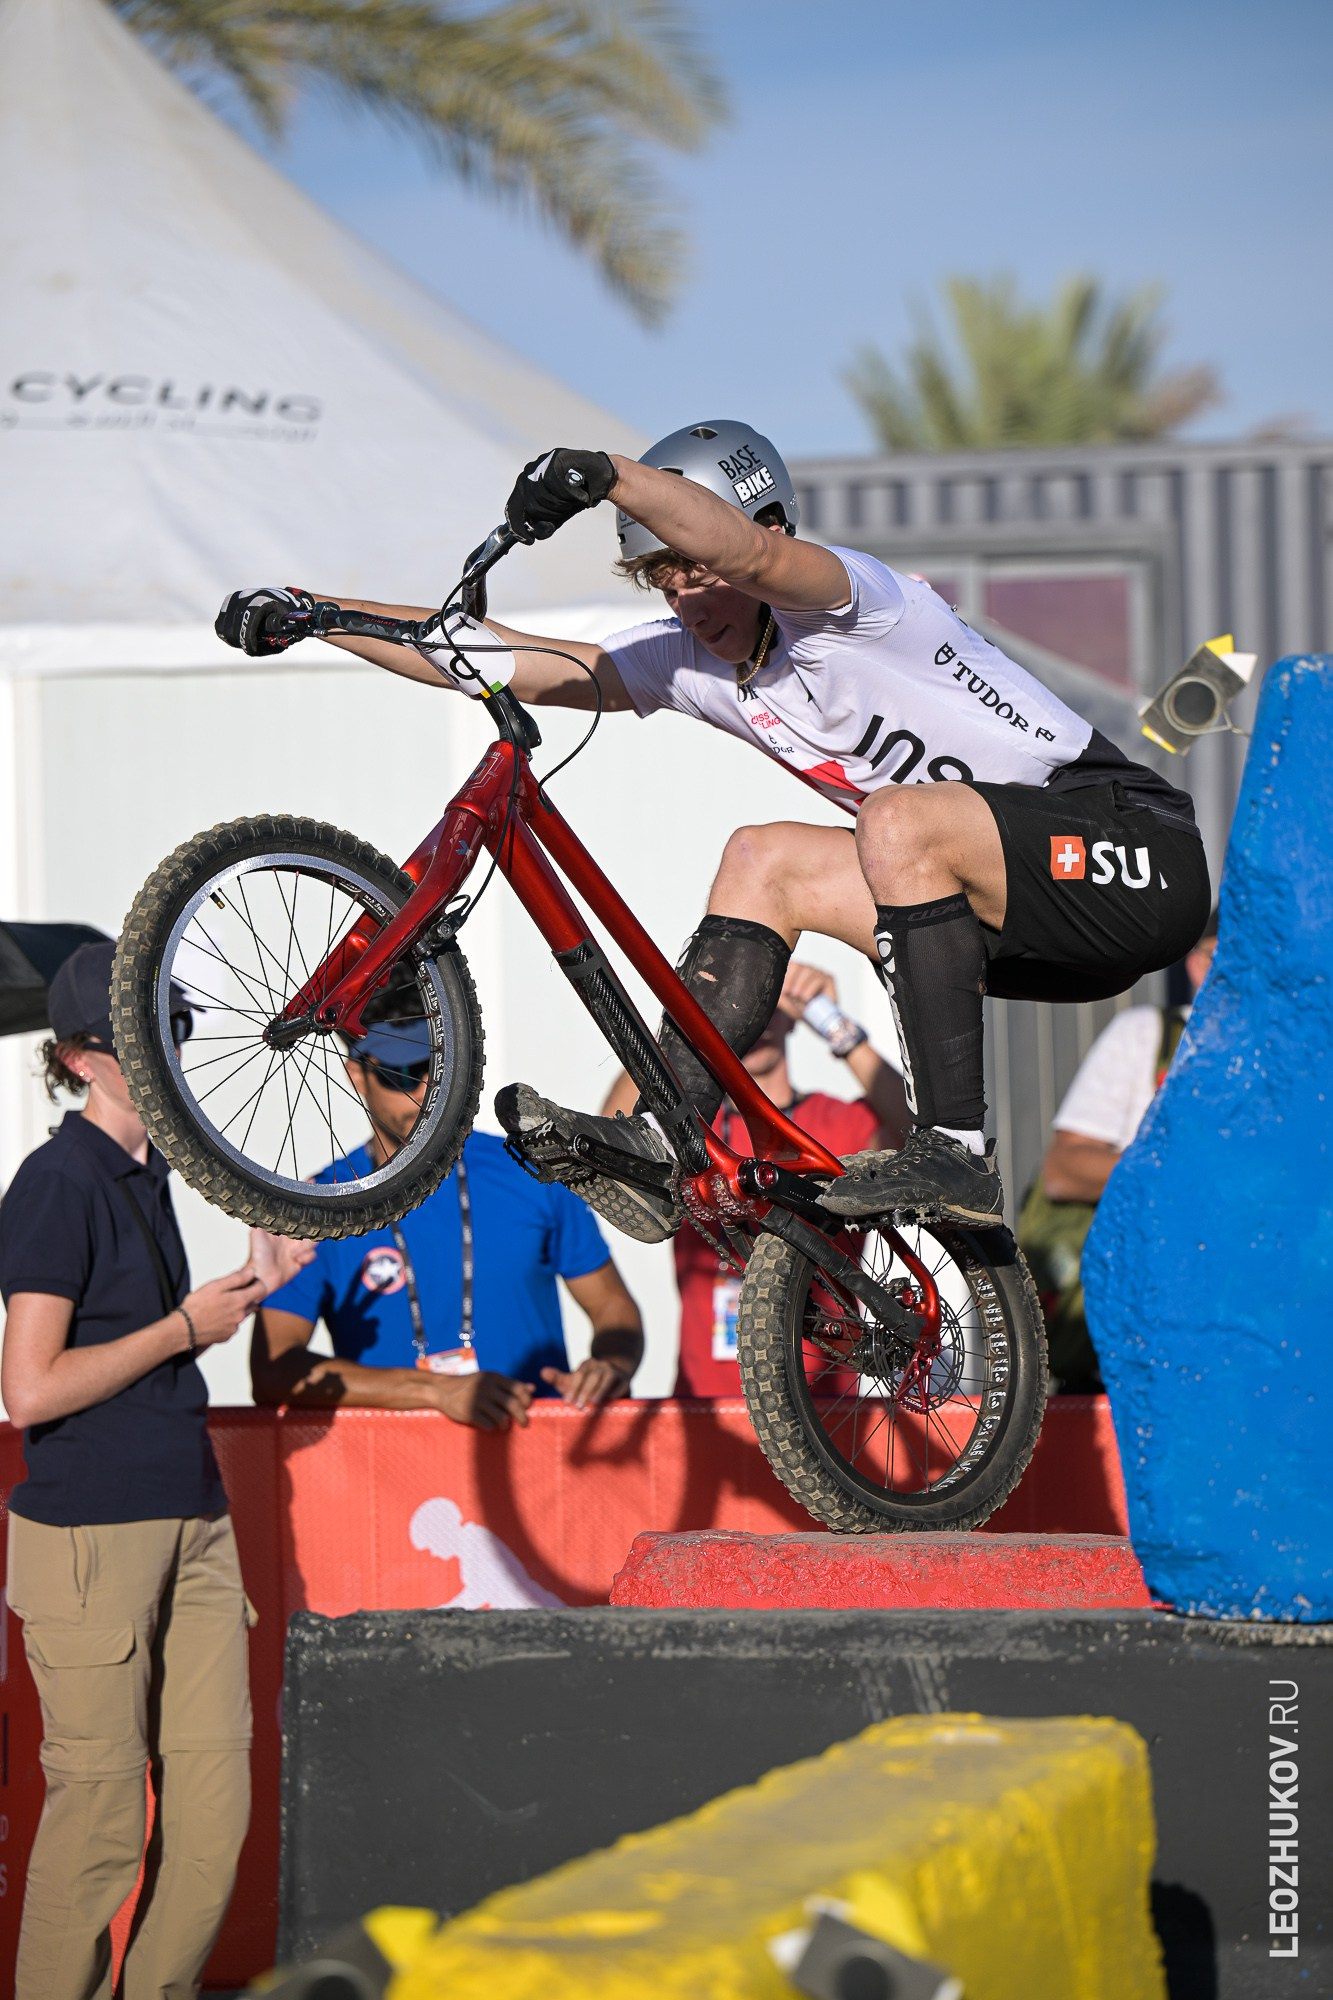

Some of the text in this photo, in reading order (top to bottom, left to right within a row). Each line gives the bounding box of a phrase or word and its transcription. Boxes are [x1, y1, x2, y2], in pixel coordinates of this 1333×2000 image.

[9, 370, 323, 425] CYCLING
[717, 444, 762, 481] BASE
[733, 465, 775, 503] BIKE
[952, 660, 1030, 733] TUDOR
[1091, 840, 1169, 890] SU
[907, 901, 966, 922] CLEAN
